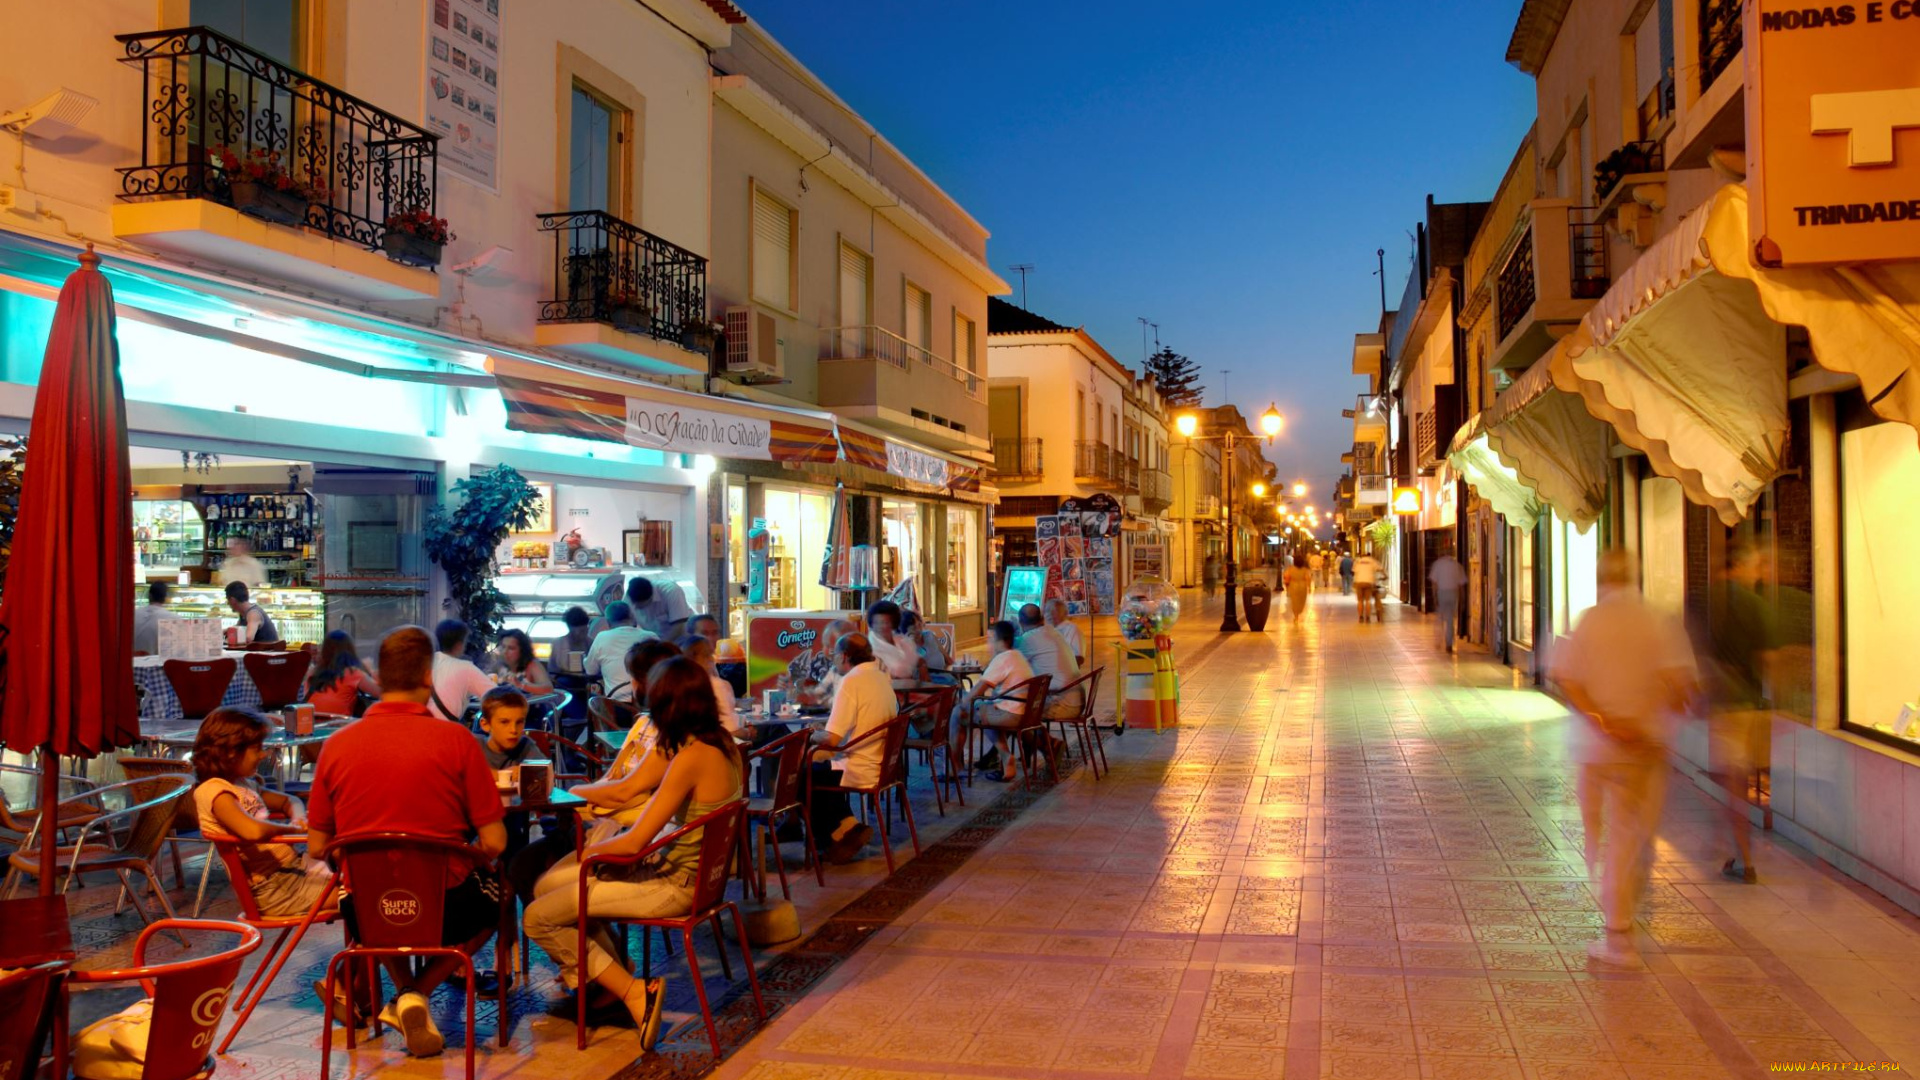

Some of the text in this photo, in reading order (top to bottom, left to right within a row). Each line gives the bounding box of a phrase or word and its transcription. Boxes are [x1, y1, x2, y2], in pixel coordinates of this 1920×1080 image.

[1761, 5, 1857, 32] MODAS
[1866, 2, 1883, 23] E
[1810, 87, 1920, 168] T
[1793, 199, 1920, 227] TRINDADE
[711, 418, 725, 444] da
[777, 630, 816, 648] Cornetto
[382, 898, 417, 908] SUPER
[384, 907, 416, 916] BOCK
